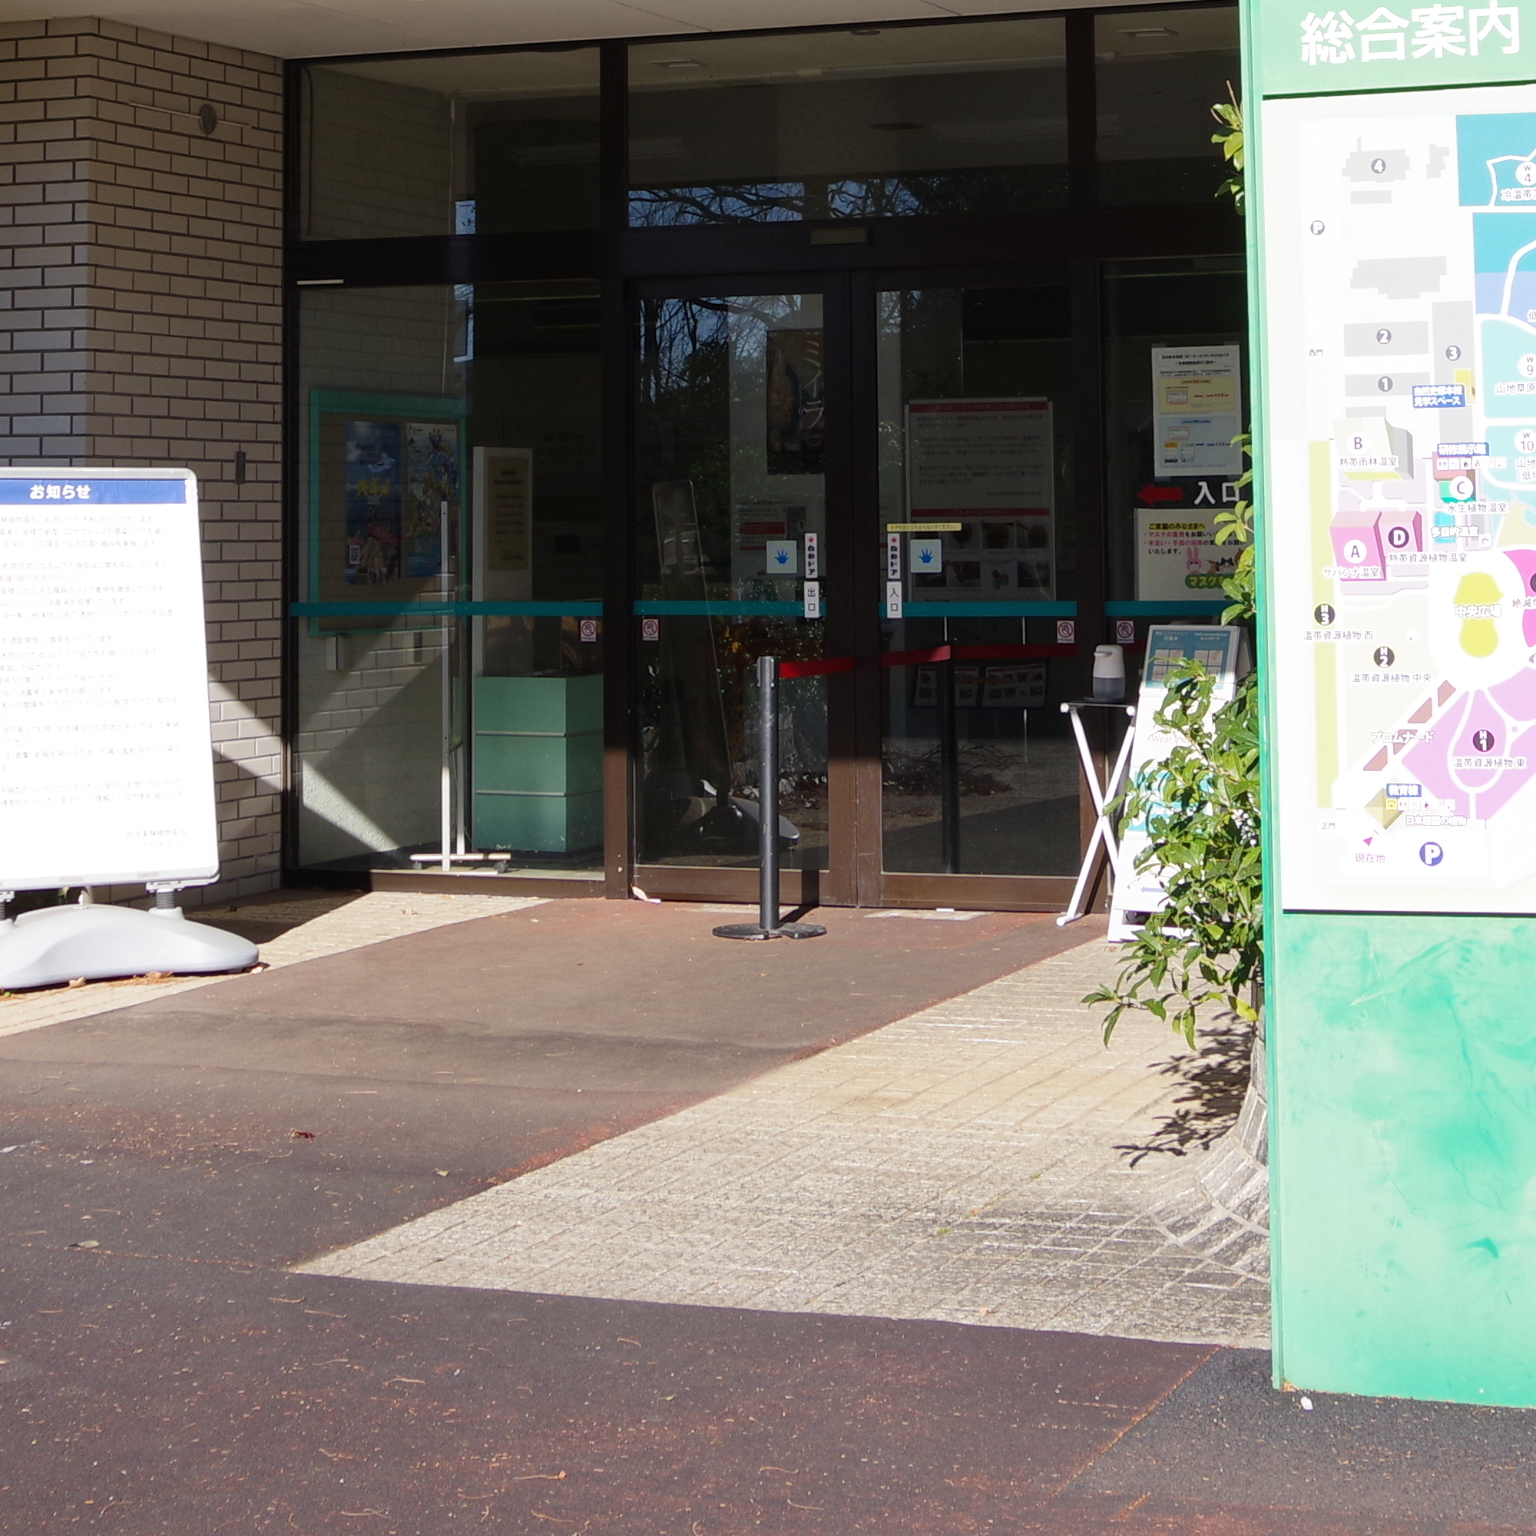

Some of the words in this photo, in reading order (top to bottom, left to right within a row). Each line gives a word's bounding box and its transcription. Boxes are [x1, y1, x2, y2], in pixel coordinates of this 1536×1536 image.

[1300, 0, 1520, 65] 総合案内
[29, 485, 90, 500] お知らせ
[1194, 481, 1240, 505] 入口
[807, 587, 816, 611] 出口
[889, 587, 899, 612] 入口
[1371, 730, 1435, 744] プロムナード
[1355, 853, 1386, 863] 現在地
